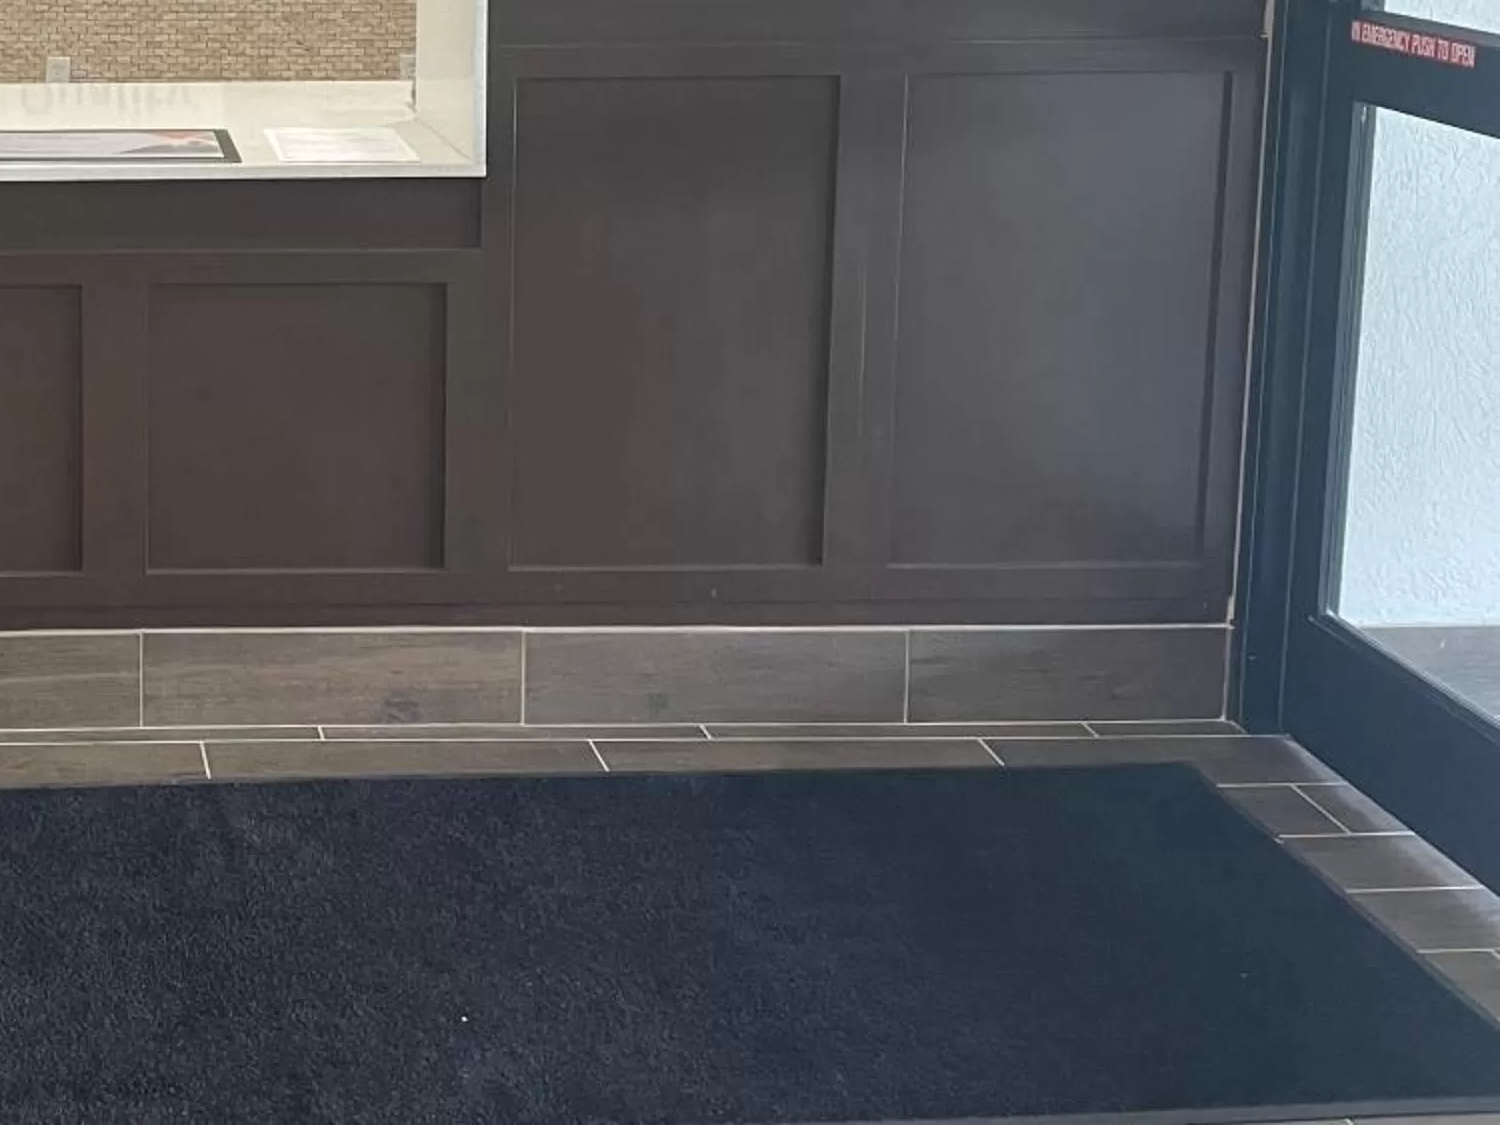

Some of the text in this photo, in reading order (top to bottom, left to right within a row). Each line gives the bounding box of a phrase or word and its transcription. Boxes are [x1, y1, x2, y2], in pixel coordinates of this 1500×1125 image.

[1362, 23, 1410, 52] EMERGENCY
[1411, 35, 1435, 58] PUSH
[1437, 38, 1449, 61] TO
[1451, 42, 1476, 68] OPEN
